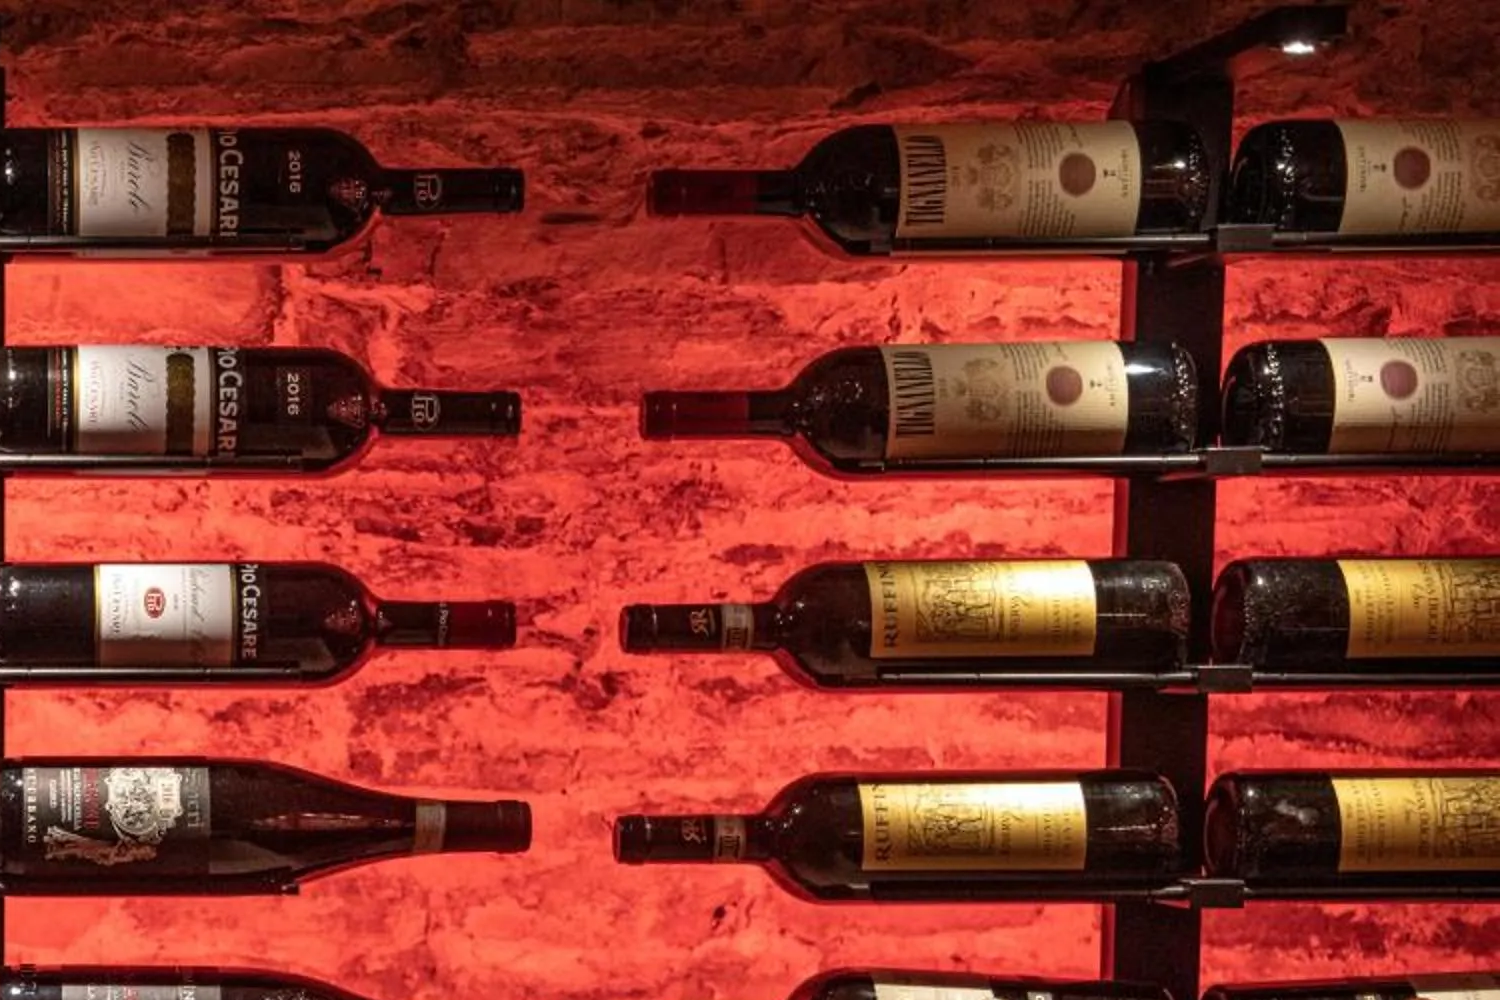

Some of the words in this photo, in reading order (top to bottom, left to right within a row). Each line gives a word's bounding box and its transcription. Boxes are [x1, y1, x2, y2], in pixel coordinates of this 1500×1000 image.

[288, 150, 302, 193] 2016
[904, 134, 947, 226] TIGNANELLO
[125, 356, 156, 434] Barolo
[287, 373, 300, 416] 2016
[893, 351, 935, 437] TIGNANELLO
[241, 584, 261, 659] CESARE
